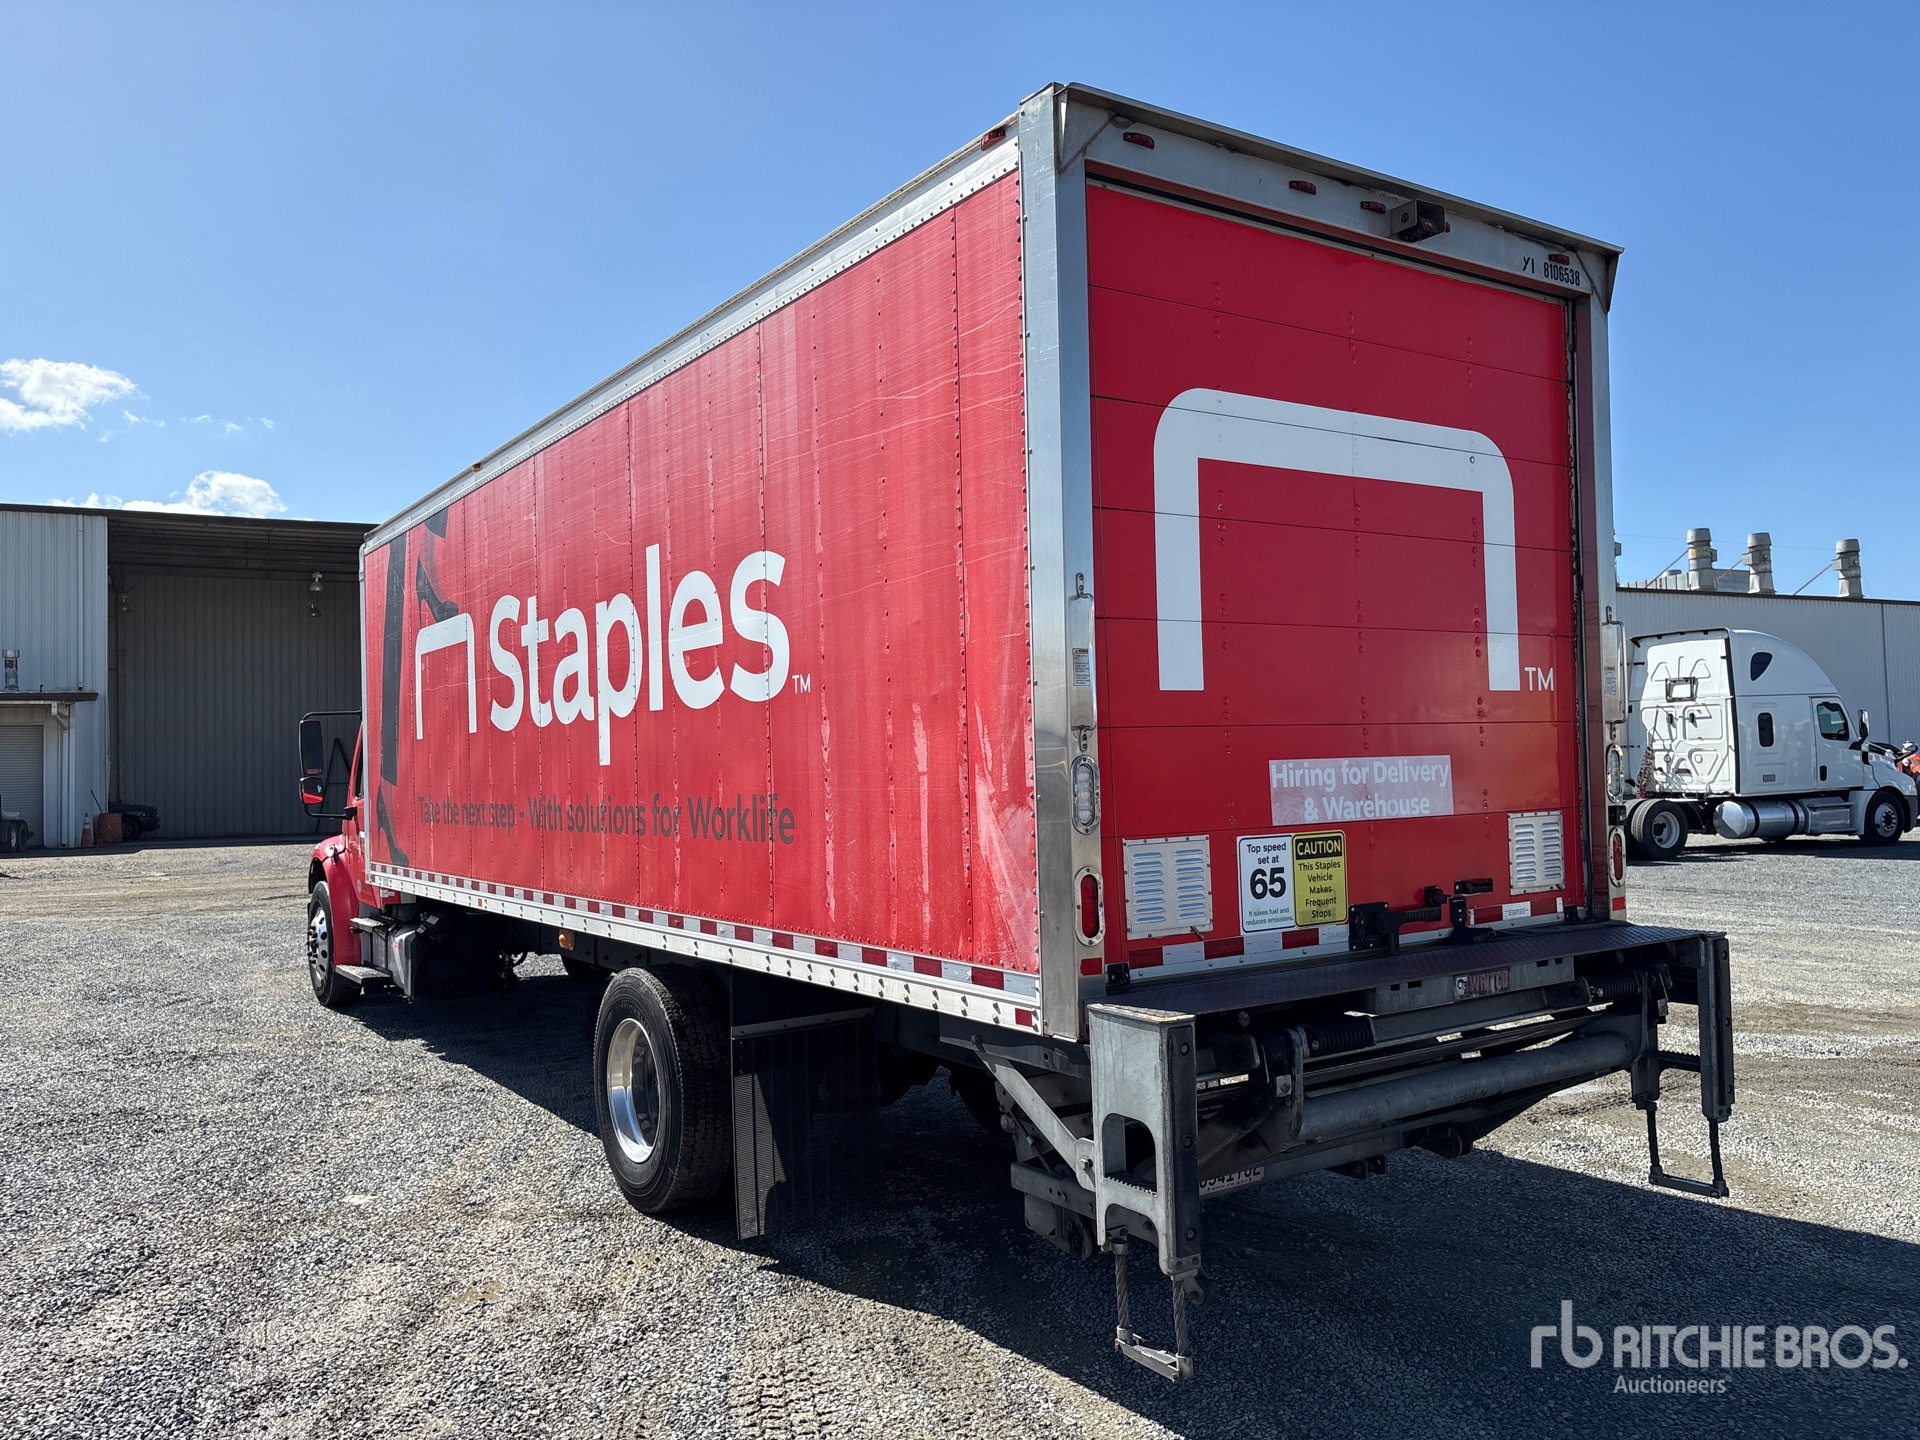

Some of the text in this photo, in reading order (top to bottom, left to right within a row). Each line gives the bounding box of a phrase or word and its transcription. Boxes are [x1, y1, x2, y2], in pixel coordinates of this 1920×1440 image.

[1544, 262, 1580, 286] 8106538
[792, 674, 811, 694] TM
[1524, 667, 1554, 691] TM
[1270, 758, 1450, 792] Hiring for Delivery
[1303, 793, 1431, 822] & Warehouse
[418, 795, 440, 824] Take
[442, 795, 459, 825] the
[462, 800, 486, 827] next
[489, 799, 515, 837] step
[528, 795, 563, 831] With
[567, 794, 647, 837] solutions
[652, 793, 682, 838] for
[687, 793, 795, 844] Worklife
[1247, 842, 1287, 854] Top speed
[1297, 840, 1341, 856] CAUTION
[1257, 855, 1280, 864] set at
[1298, 860, 1341, 871] This Staples
[1250, 866, 1287, 900] 65
[1307, 873, 1333, 883] Vehicle
[1309, 885, 1332, 895] Makes
[1305, 897, 1337, 908] Frequent
[1269, 908, 1279, 916] fuel
[1312, 909, 1332, 919] Stops
[1246, 918, 1267, 926] reduces
